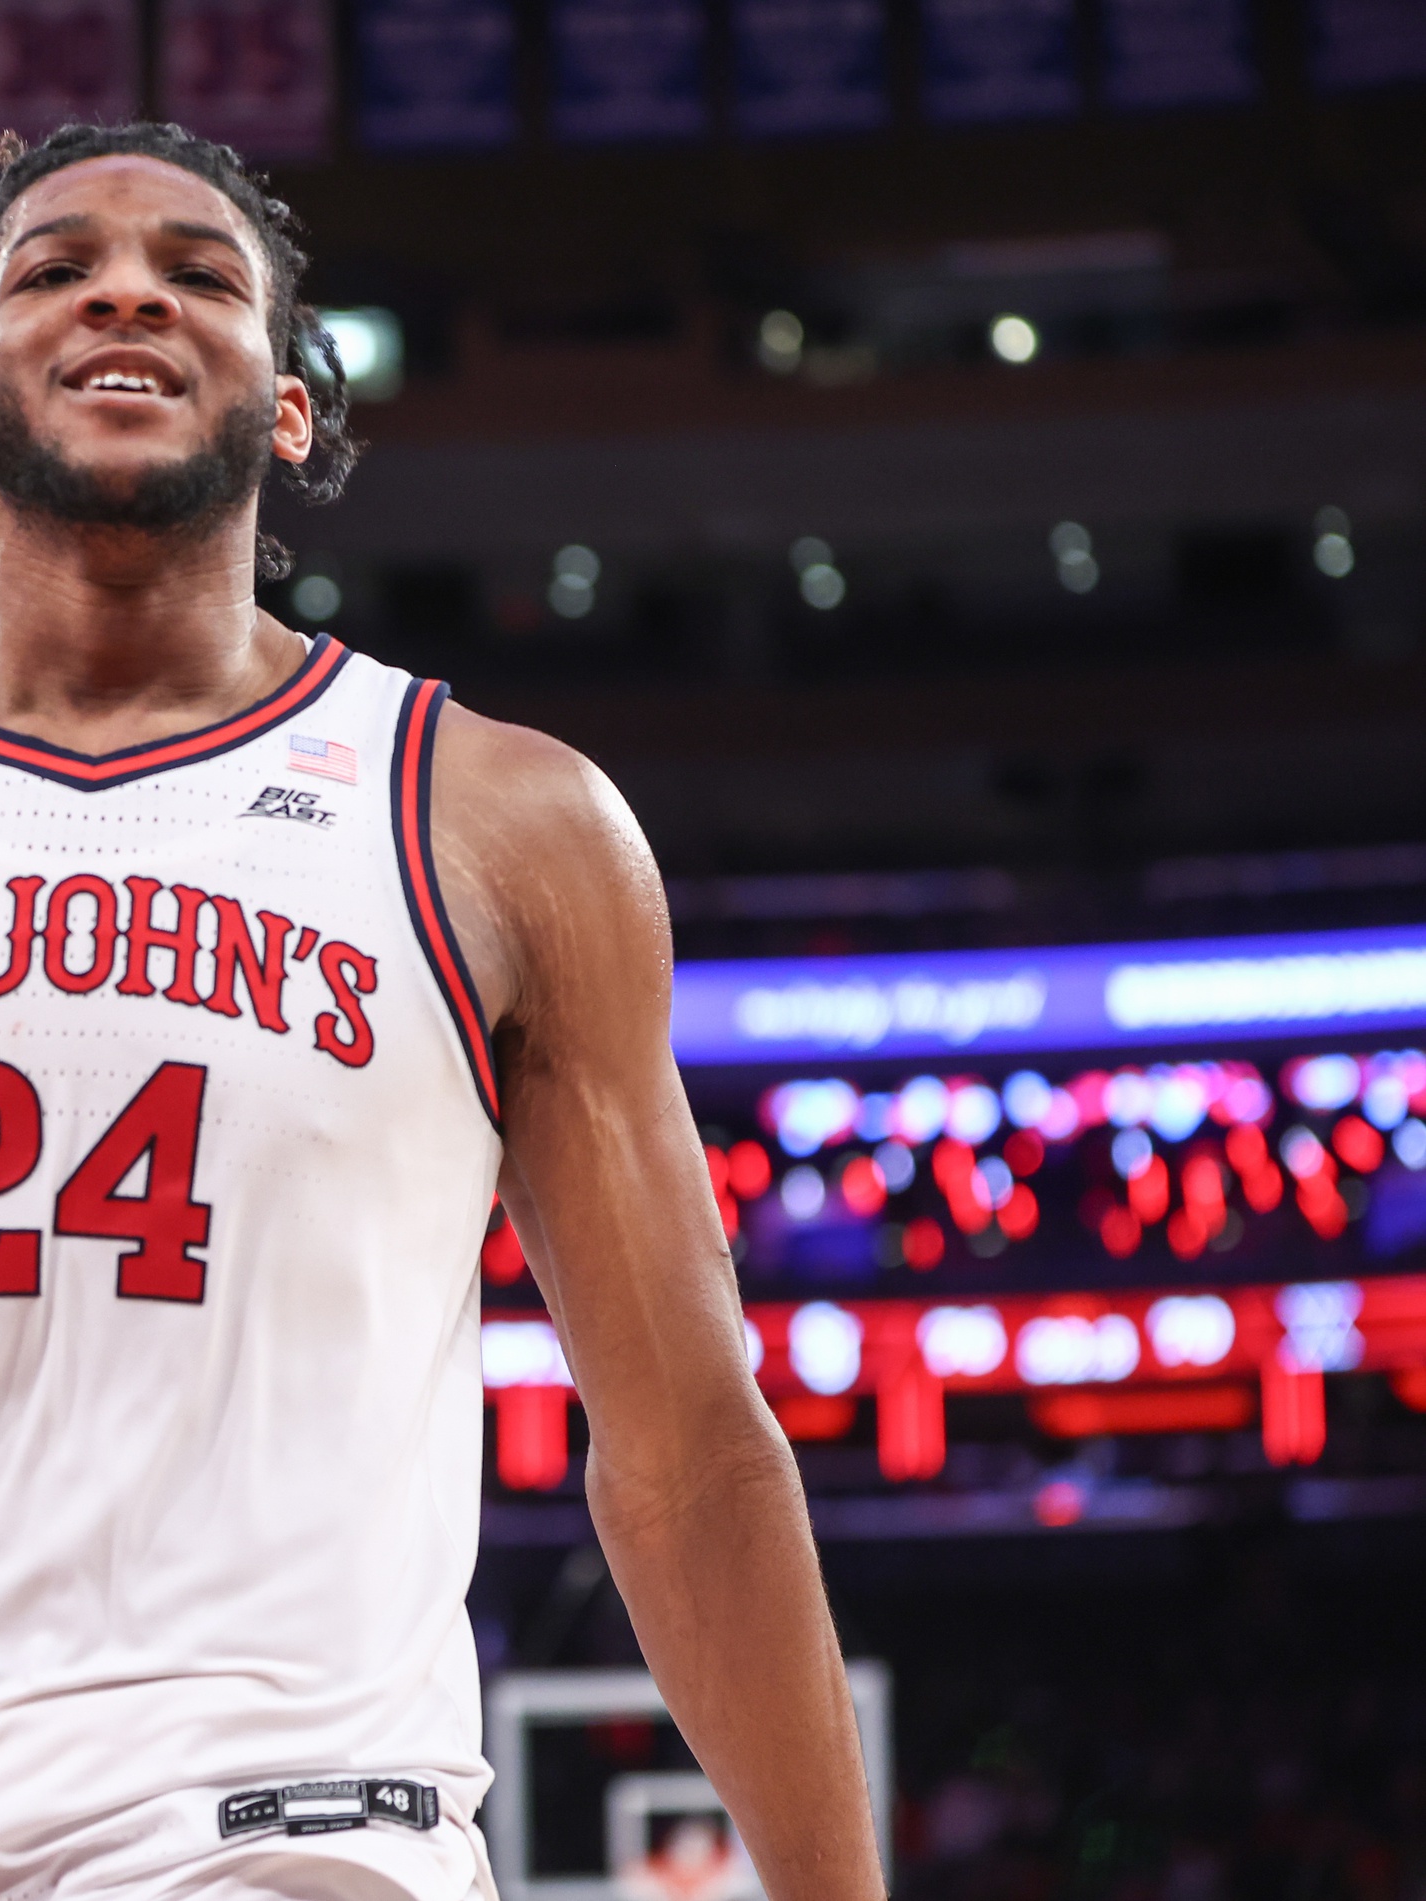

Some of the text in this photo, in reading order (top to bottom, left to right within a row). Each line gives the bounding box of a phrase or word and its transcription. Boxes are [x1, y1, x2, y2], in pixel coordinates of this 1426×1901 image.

[259, 786, 321, 805] BIG
[248, 800, 337, 823] EAST
[376, 1785, 410, 1812] 48
